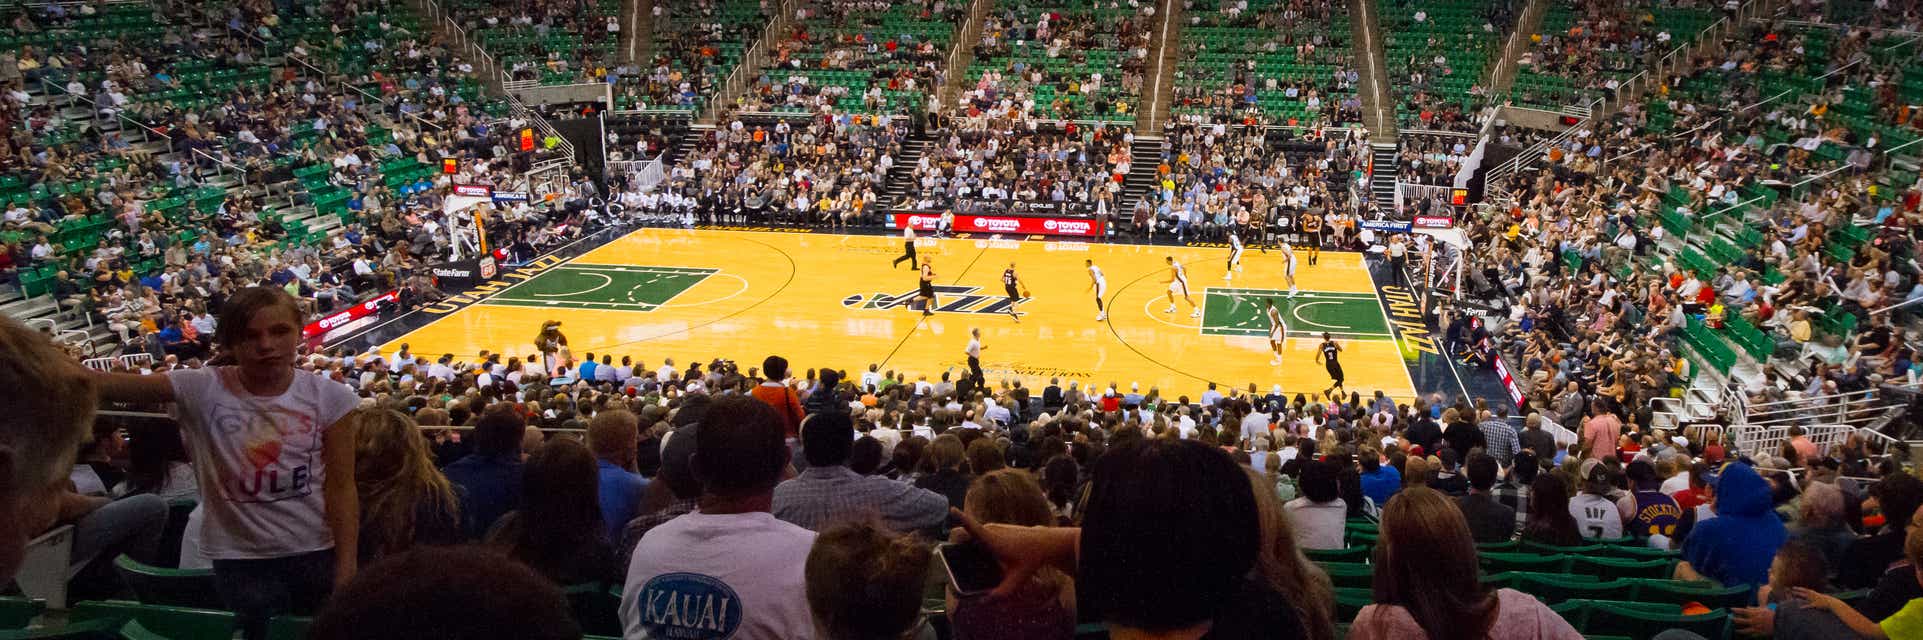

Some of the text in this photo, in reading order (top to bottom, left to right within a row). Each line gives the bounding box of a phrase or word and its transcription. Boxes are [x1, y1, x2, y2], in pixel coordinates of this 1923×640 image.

[987, 219, 1020, 227] TOYOTA
[1057, 221, 1090, 230] TOYOTA
[421, 280, 511, 314] UTAH
[503, 254, 572, 280] JAZZ
[1382, 285, 1441, 355] UTAH JAZZ
[1587, 525, 1604, 538] 7
[645, 588, 730, 632] KAUAI
